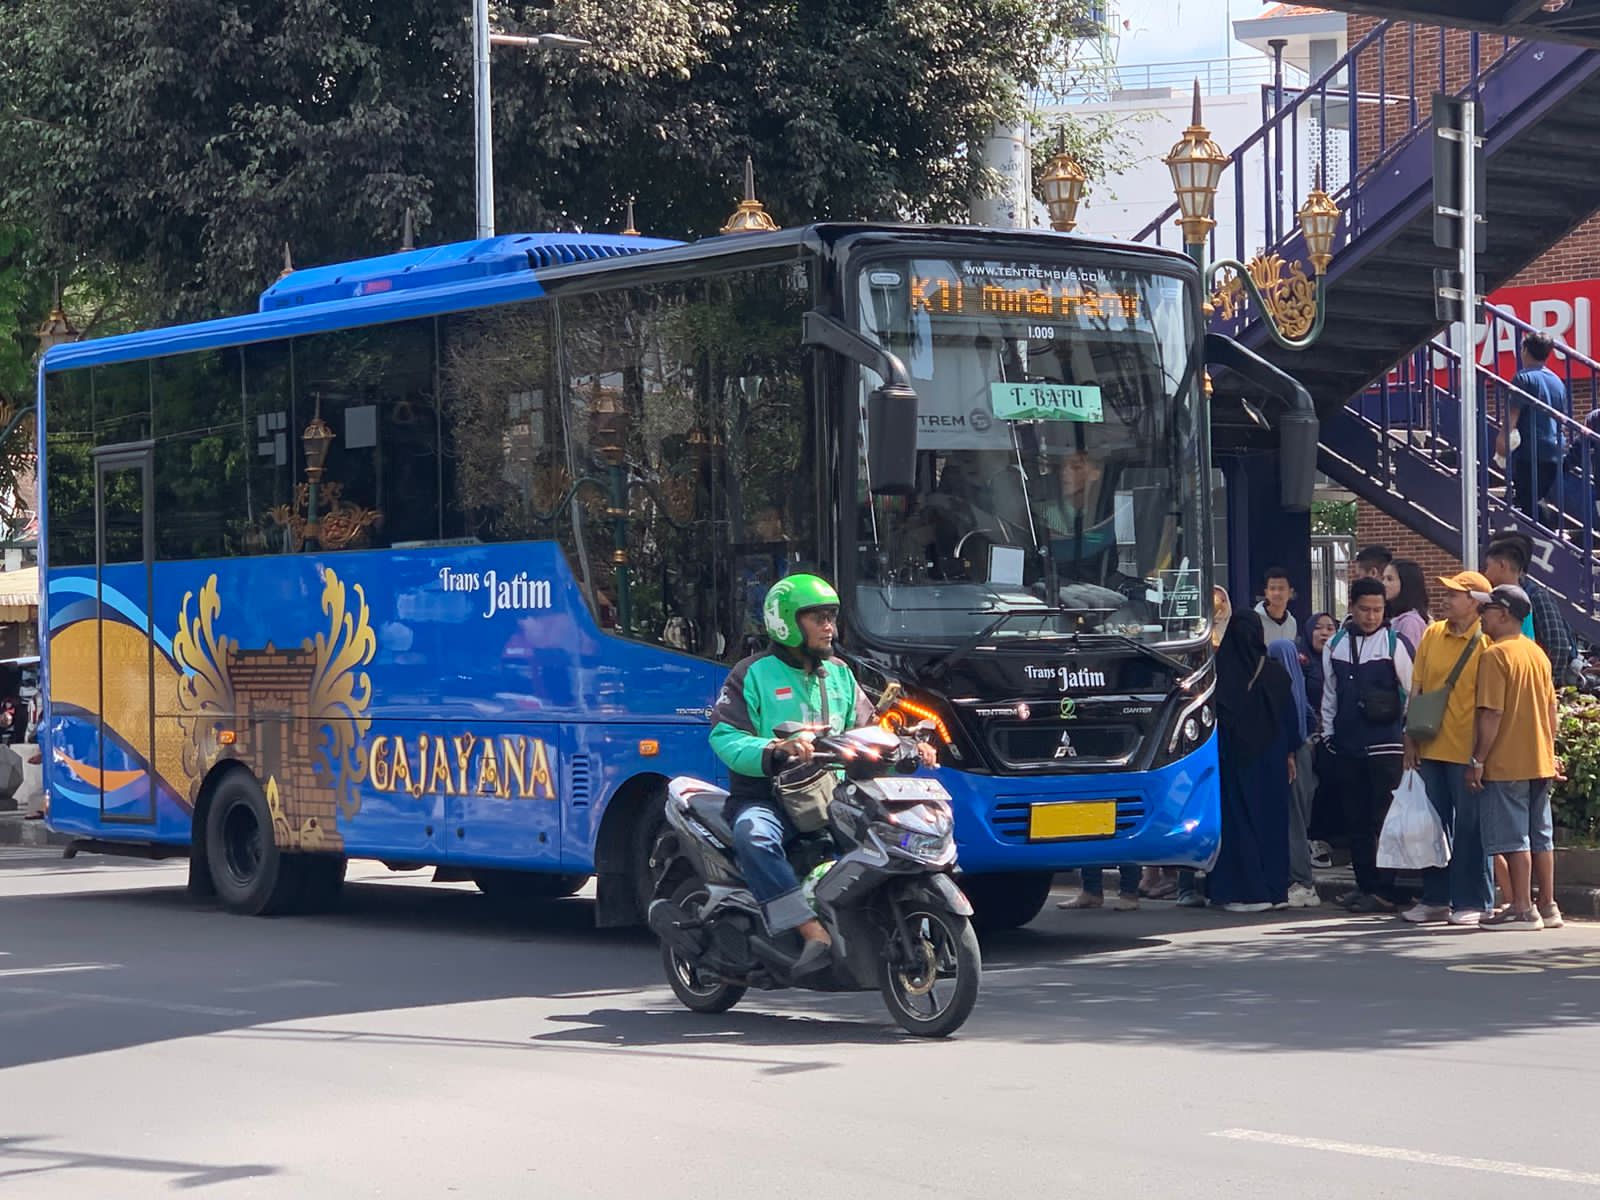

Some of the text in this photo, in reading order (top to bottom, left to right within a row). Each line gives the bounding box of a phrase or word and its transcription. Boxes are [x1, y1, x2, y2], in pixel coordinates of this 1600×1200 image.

[1030, 387, 1084, 409] BATU
[439, 567, 552, 618] Trans Jatim
[1024, 665, 1106, 692] Trans Jatim
[369, 732, 556, 800] GAJAYANA
